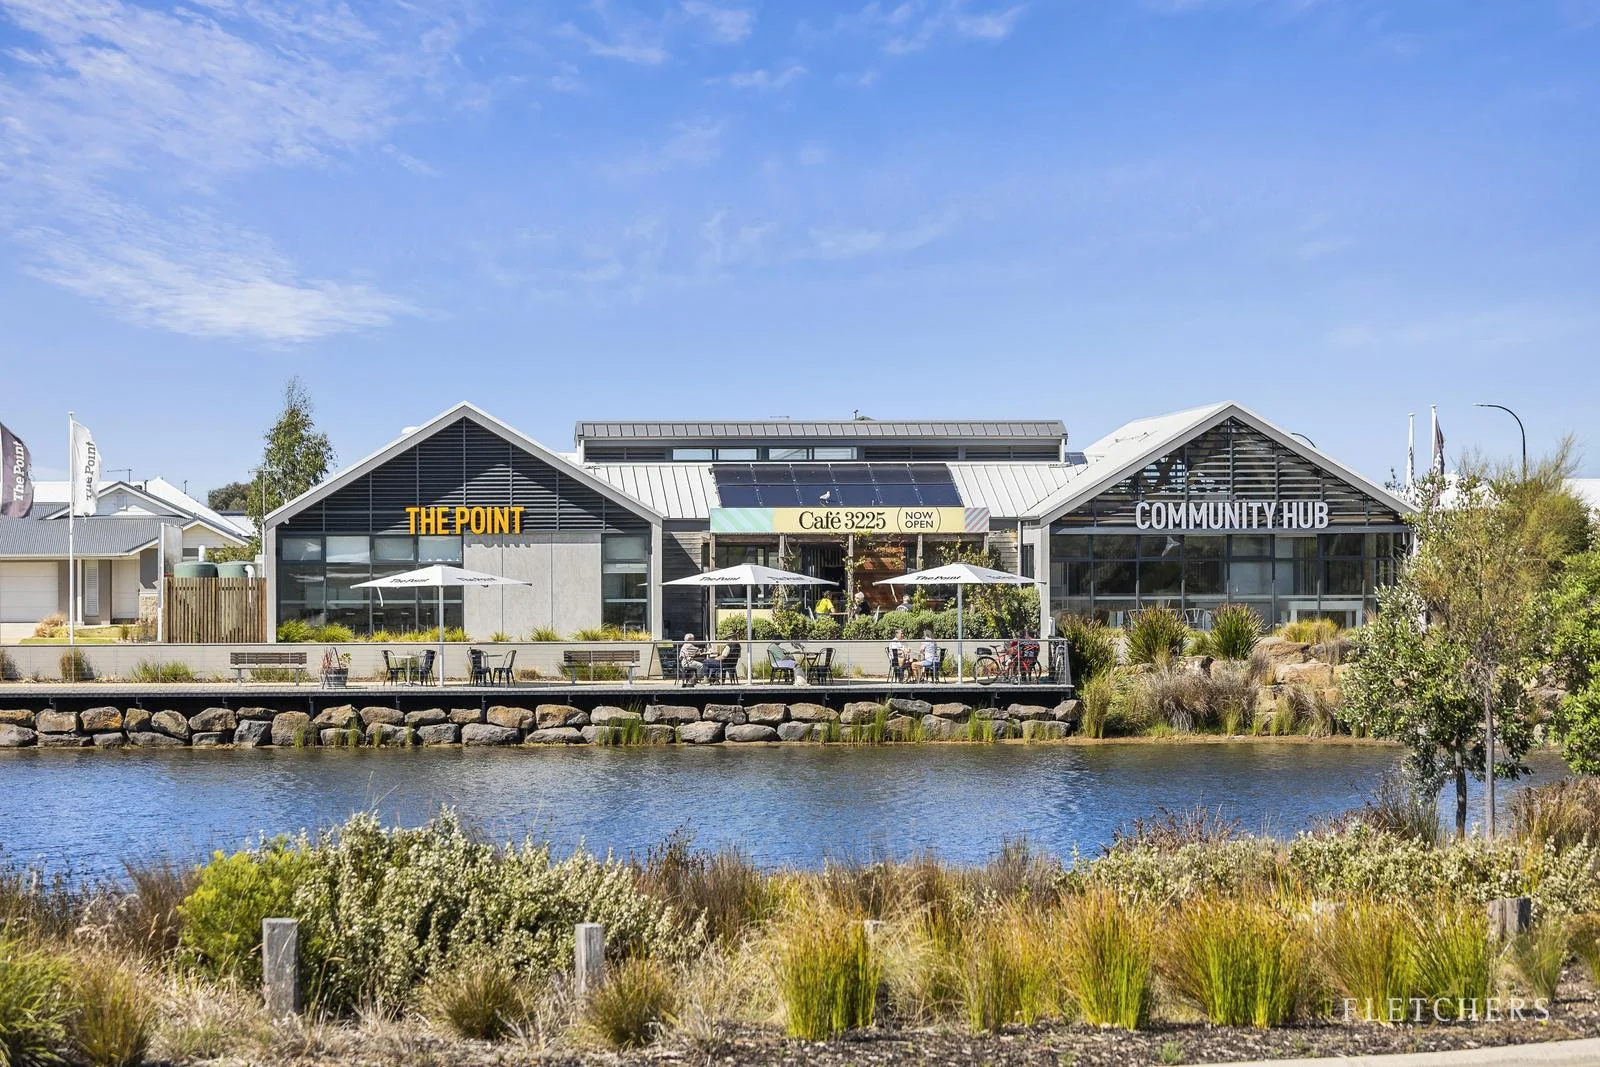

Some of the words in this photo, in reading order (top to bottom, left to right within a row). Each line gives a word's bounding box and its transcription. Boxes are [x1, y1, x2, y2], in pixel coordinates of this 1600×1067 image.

[12, 441, 25, 476] Point
[85, 441, 96, 475] Point
[13, 476, 25, 501] The
[405, 506, 450, 535] THE
[455, 506, 525, 535] POINT
[798, 511, 842, 530] Café
[844, 511, 887, 530] 3225
[904, 520, 934, 529] OPEN
[905, 511, 934, 520] NOW
[1135, 502, 1277, 530] COMMUNITY
[1283, 502, 1329, 529] HUB
